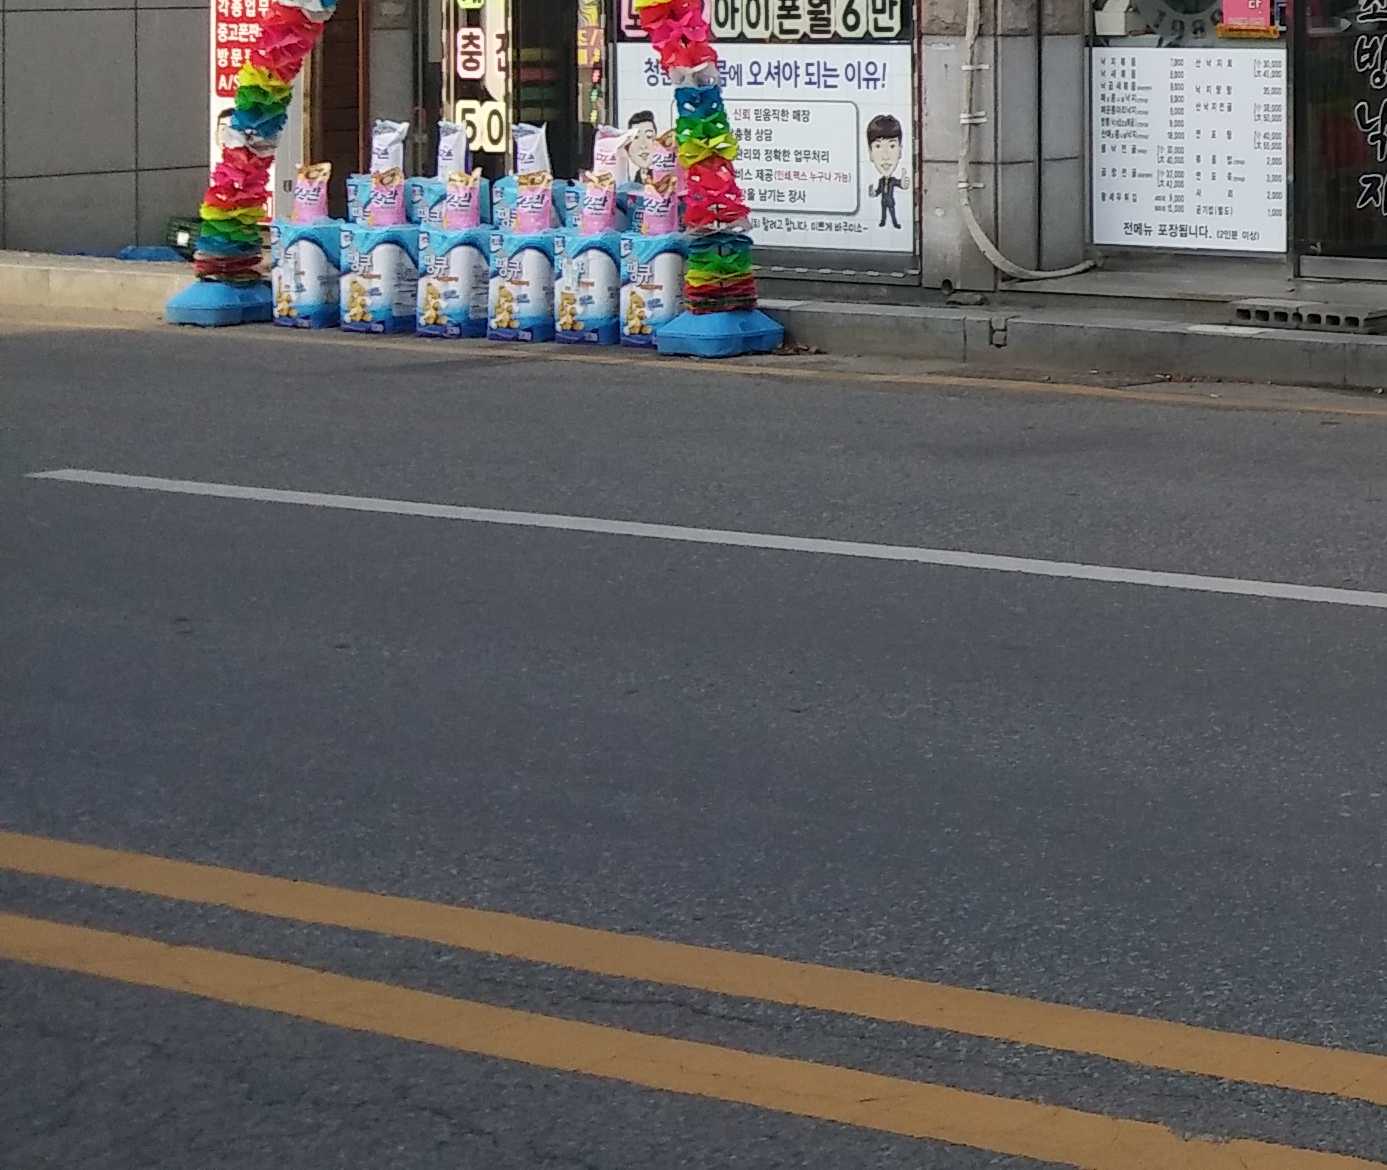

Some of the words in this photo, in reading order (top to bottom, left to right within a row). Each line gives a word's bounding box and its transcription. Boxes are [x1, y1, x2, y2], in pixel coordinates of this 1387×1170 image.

[747, 60, 800, 88] 오셔야
[805, 61, 839, 88] 되는
[844, 61, 887, 89] 이유!
[755, 129, 773, 142] 상담
[764, 149, 791, 162] 정확한
[794, 150, 830, 163] 업무처리
[759, 188, 786, 202] 남기는
[788, 189, 807, 202] 장사
[1123, 222, 1153, 237] 전메뉴
[1158, 223, 1212, 239] 포장됩니다.
